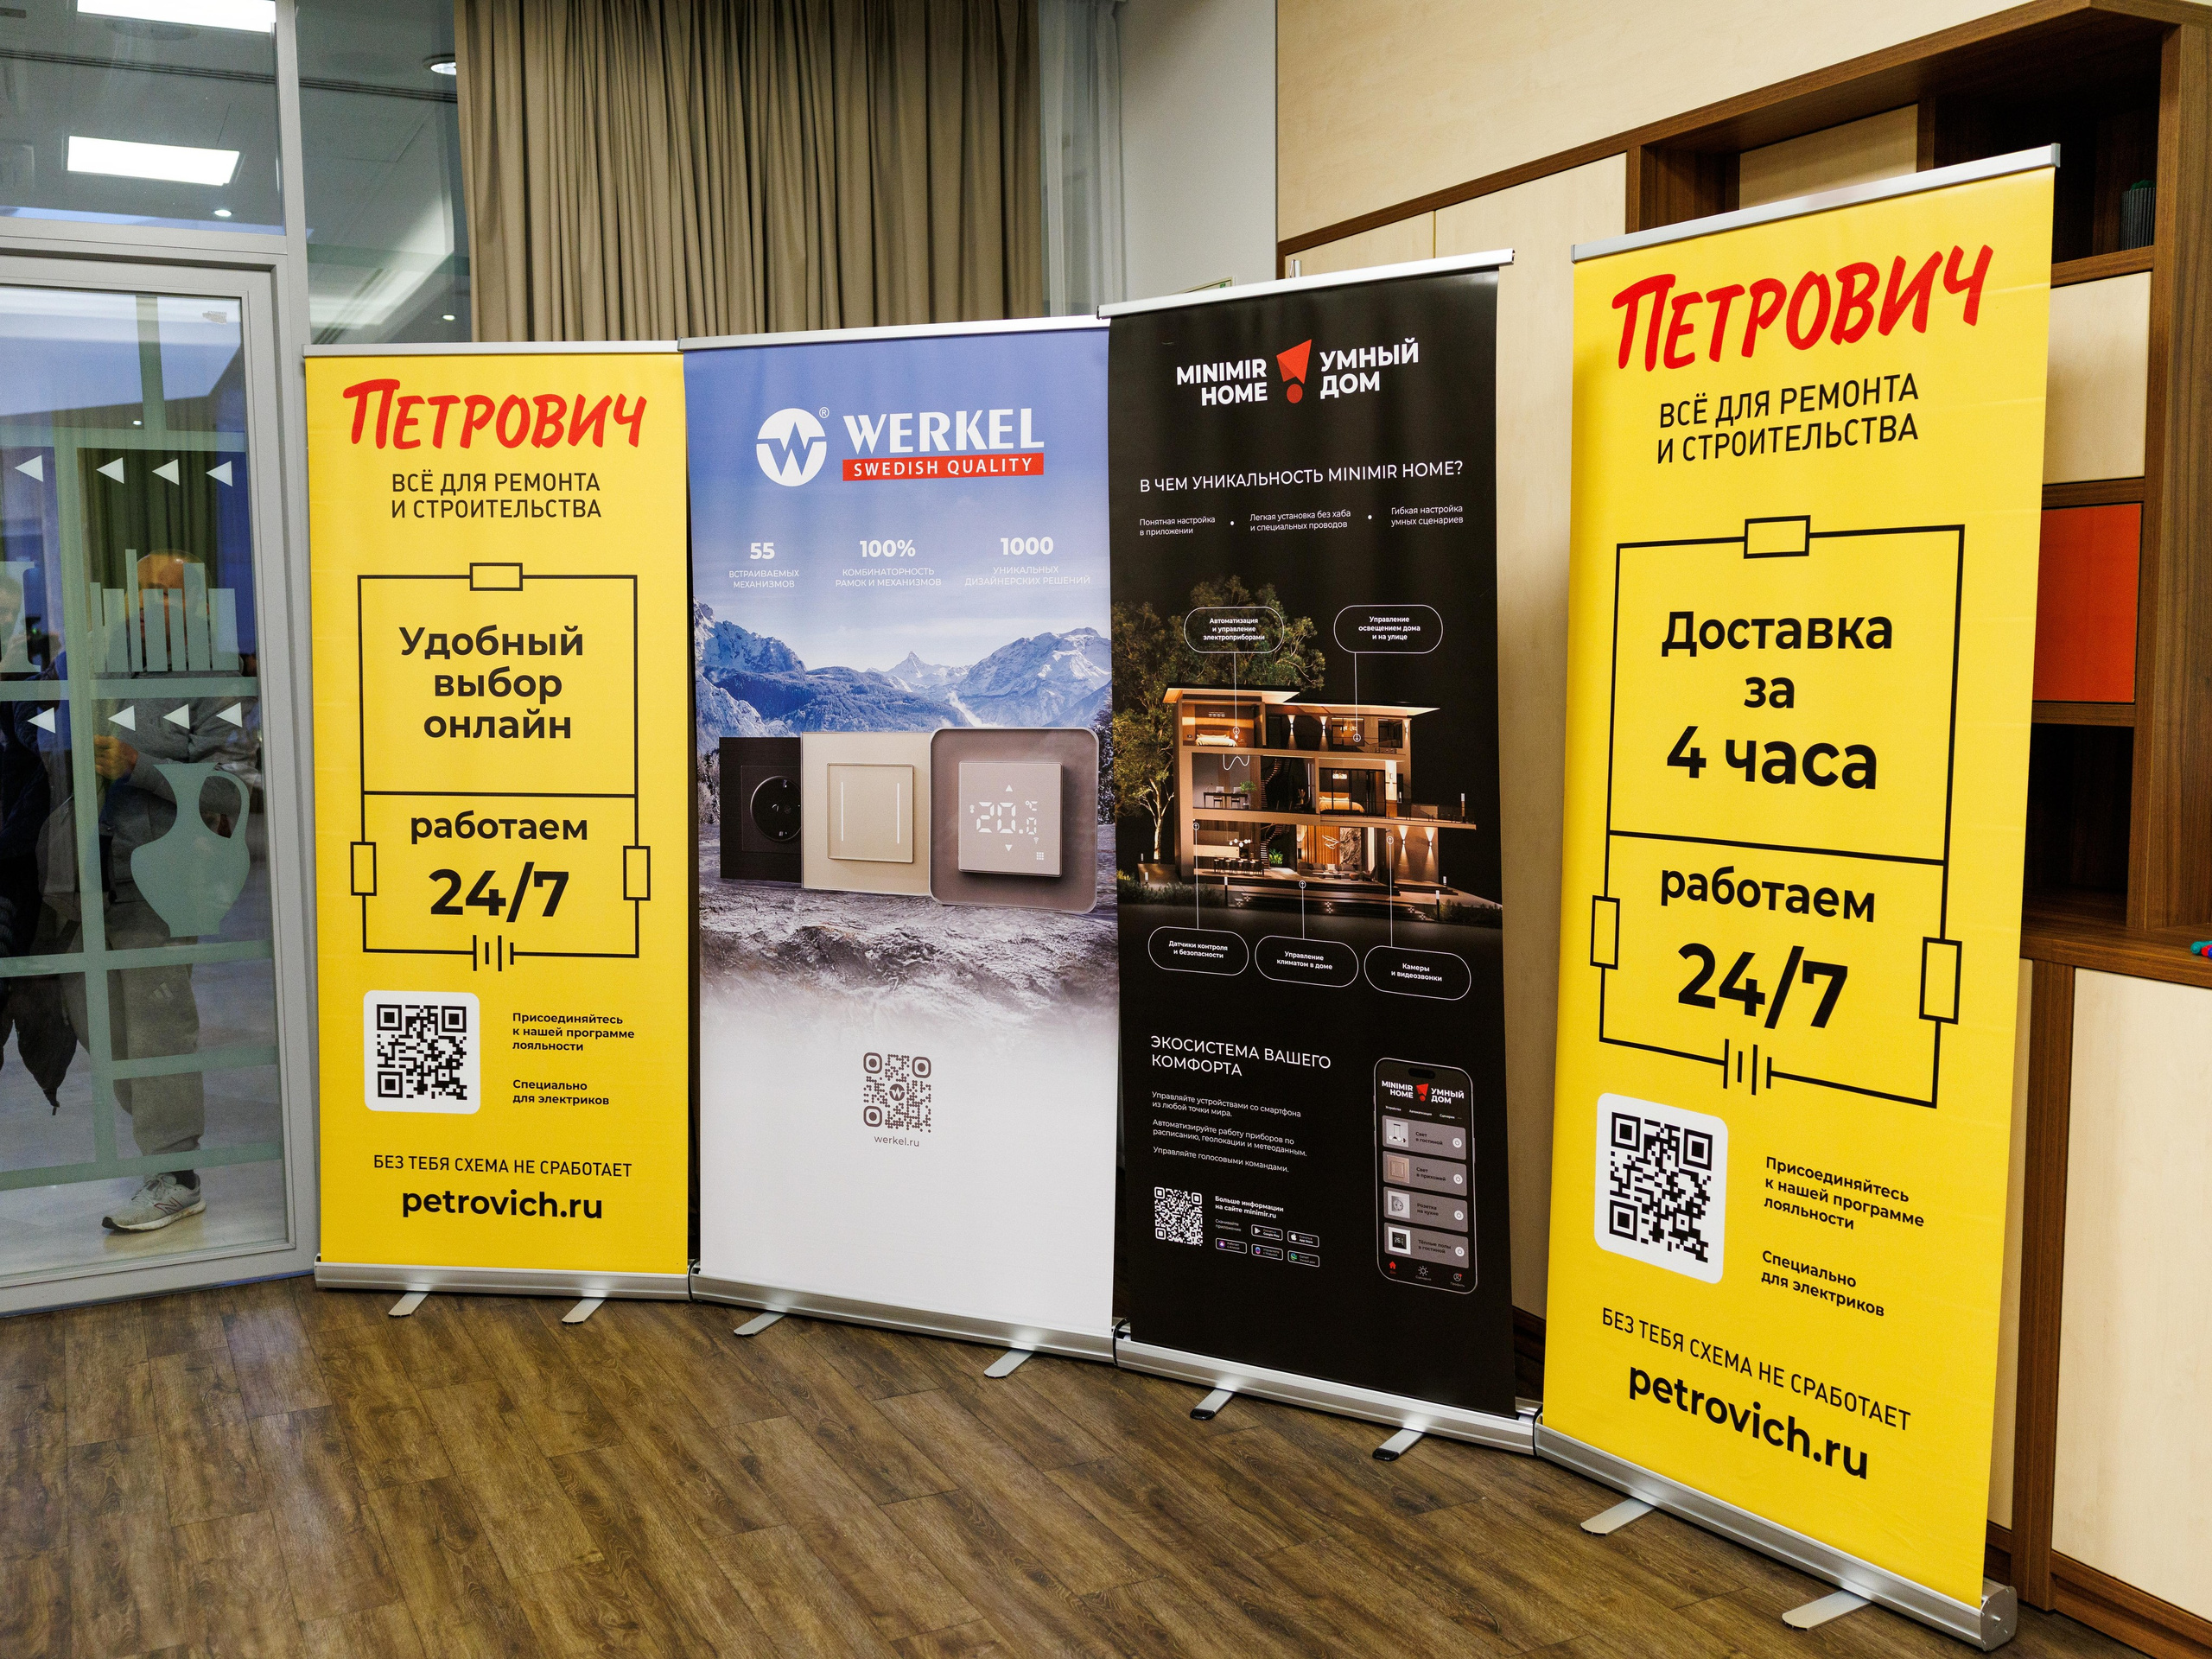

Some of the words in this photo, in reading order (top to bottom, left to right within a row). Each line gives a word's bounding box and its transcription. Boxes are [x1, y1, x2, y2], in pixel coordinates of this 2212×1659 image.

[1319, 337, 1419, 372] УМНЫЙ
[1177, 359, 1267, 385] MINIMIR
[1201, 382, 1268, 406] HOME
[1320, 371, 1380, 399] ДОМ
[1660, 392, 1707, 428] ВСЁ
[1715, 391, 1770, 428] ДЛЯ
[1781, 373, 1918, 414] РЕМОНТА
[842, 408, 1045, 454] WERKEL
[1658, 438, 1673, 464] И
[1683, 410, 1918, 461] СТРОИТЕЛЬСТВА
[855, 461, 938, 477] SWEDISH
[948, 458, 1032, 475] QUALITY
[392, 469, 433, 492] ВСЁ
[441, 474, 486, 496] ДЛЯ
[495, 473, 600, 492] РЕМОНТА
[1141, 480, 1150, 493] В
[1154, 477, 1187, 491] ЧЕМ
[1192, 469, 1323, 490] УНИКАЛЬНОСТЬ
[1329, 465, 1397, 481] MINIMIR
[1402, 461, 1463, 478] HOME?
[392, 500, 405, 518] И
[414, 499, 601, 518] СТРОИТЕЛЬСТВА
[1277, 512, 1315, 522] установка
[1317, 510, 1331, 518] без
[1332, 509, 1351, 518] хаба
[1391, 506, 1418, 515] Гибкая
[1421, 505, 1463, 514] настройка
[1177, 516, 1215, 525] настройка
[1309, 522, 1348, 531] проводов
[1391, 518, 1417, 527] умных
[1418, 517, 1464, 525] сценариев
[1146, 528, 1193, 537] приложении
[750, 542, 775, 559] 55
[860, 539, 916, 557] 100%
[1001, 537, 1053, 556] 1000
[729, 569, 799, 578] ВСТРАИВАЕМЫХ
[842, 568, 935, 576] КОМБИНАТОРНОСТЬ
[993, 566, 1058, 575] УНИКАЛЬНЫХ
[734, 580, 795, 588] МЕХАНИЗМОВ
[868, 578, 874, 587] И
[877, 578, 942, 588] МЕХАНИЗМОВ
[964, 575, 1040, 587] ДИЗАЙНЕРСКИХ
[1043, 575, 1090, 584] РЕШЕНИЙ
[1209, 616, 1259, 625] Автоматизация
[1217, 625, 1256, 634] управление
[1358, 624, 1401, 633] освещением
[1402, 624, 1421, 633] дома
[398, 624, 582, 659] Удобный
[1203, 632, 1266, 642] электроприборами
[1387, 632, 1408, 642] улице
[1662, 611, 1892, 657] Доставка
[435, 665, 562, 704] выбор
[1744, 677, 1795, 709] за
[424, 709, 570, 739] онлайн
[1667, 726, 1707, 779] 4
[1726, 739, 1877, 790] часа
[411, 810, 588, 845] работаем
[429, 861, 569, 923] 24/7
[1661, 866, 1875, 923] работаем
[1168, 939, 1198, 950] Датчики
[1198, 944, 1228, 952] контроля
[1179, 949, 1224, 958] безопасности
[1276, 957, 1307, 968] климатом
[1314, 962, 1333, 970] доме
[1284, 951, 1324, 961] Управление
[1397, 971, 1442, 982] видеозвонки
[1402, 963, 1430, 972] Камеры
[1678, 943, 1848, 1029] 24/7
[513, 1013, 623, 1024] Присоединяйтесь
[512, 1027, 519, 1037] к
[524, 1027, 563, 1037] нашей
[567, 1030, 634, 1039] программе
[512, 1042, 583, 1051] лояльности
[1151, 1035, 1260, 1059] ЭКОСИСТЕМА
[1265, 1048, 1331, 1069] ВАШЕГО
[1152, 1054, 1243, 1076] КОМФОРТА
[513, 1079, 588, 1090] Специально
[1382, 1080, 1413, 1091] MINIMIR
[1390, 1089, 1414, 1098] HOME
[1431, 1088, 1464, 1099] УМНЫЙ
[512, 1094, 535, 1105] для
[538, 1096, 609, 1106] электриков
[1152, 1091, 1195, 1103] Управляйте
[1197, 1098, 1249, 1109] устройствами
[1260, 1106, 1301, 1117] смартфона
[1431, 1095, 1452, 1104] ДОМ
[1153, 1119, 1217, 1134] Автоматизируйте
[1218, 1128, 1244, 1137] работу
[1245, 1133, 1283, 1143] приборов
[874, 1136, 919, 1147] werkel.ru
[1153, 1129, 1200, 1141] расписанию,
[1202, 1135, 1245, 1147] геолокации
[1254, 1143, 1307, 1156] метеоданным.
[374, 1154, 404, 1169] БЕЗ
[408, 1156, 449, 1171] ТЕБЯ
[455, 1158, 509, 1173] СХЕМА
[514, 1160, 535, 1173] НЕ
[540, 1160, 632, 1177] СРАБОТАЕТ
[1153, 1146, 1197, 1159] Управляйте
[1198, 1154, 1243, 1165] голосовыми
[1245, 1160, 1289, 1173] командами.
[1765, 1156, 1909, 1205] Присоединяйтесь
[403, 1189, 601, 1218] petrovich.ru
[1215, 1196, 1240, 1205] Больше
[1242, 1201, 1284, 1212] информации
[1764, 1178, 1773, 1191] к
[1777, 1179, 1830, 1204] нашей
[1834, 1192, 1924, 1230] программе
[1764, 1194, 1853, 1230] лояльности
[1243, 1208, 1276, 1218] minimir.ru
[1761, 1250, 1856, 1291] Специально
[1761, 1272, 1788, 1287] для
[1793, 1277, 1884, 1316] электриков
[1603, 1307, 1634, 1333] БЕЗ
[1639, 1318, 1685, 1353] ТЕБЯ
[1690, 1338, 1752, 1376] СХЕМА
[1759, 1362, 1784, 1388] НЕ
[1791, 1374, 1911, 1430] СРАБОТАЕТ
[1630, 1363, 1870, 1480] petrovich.ru
